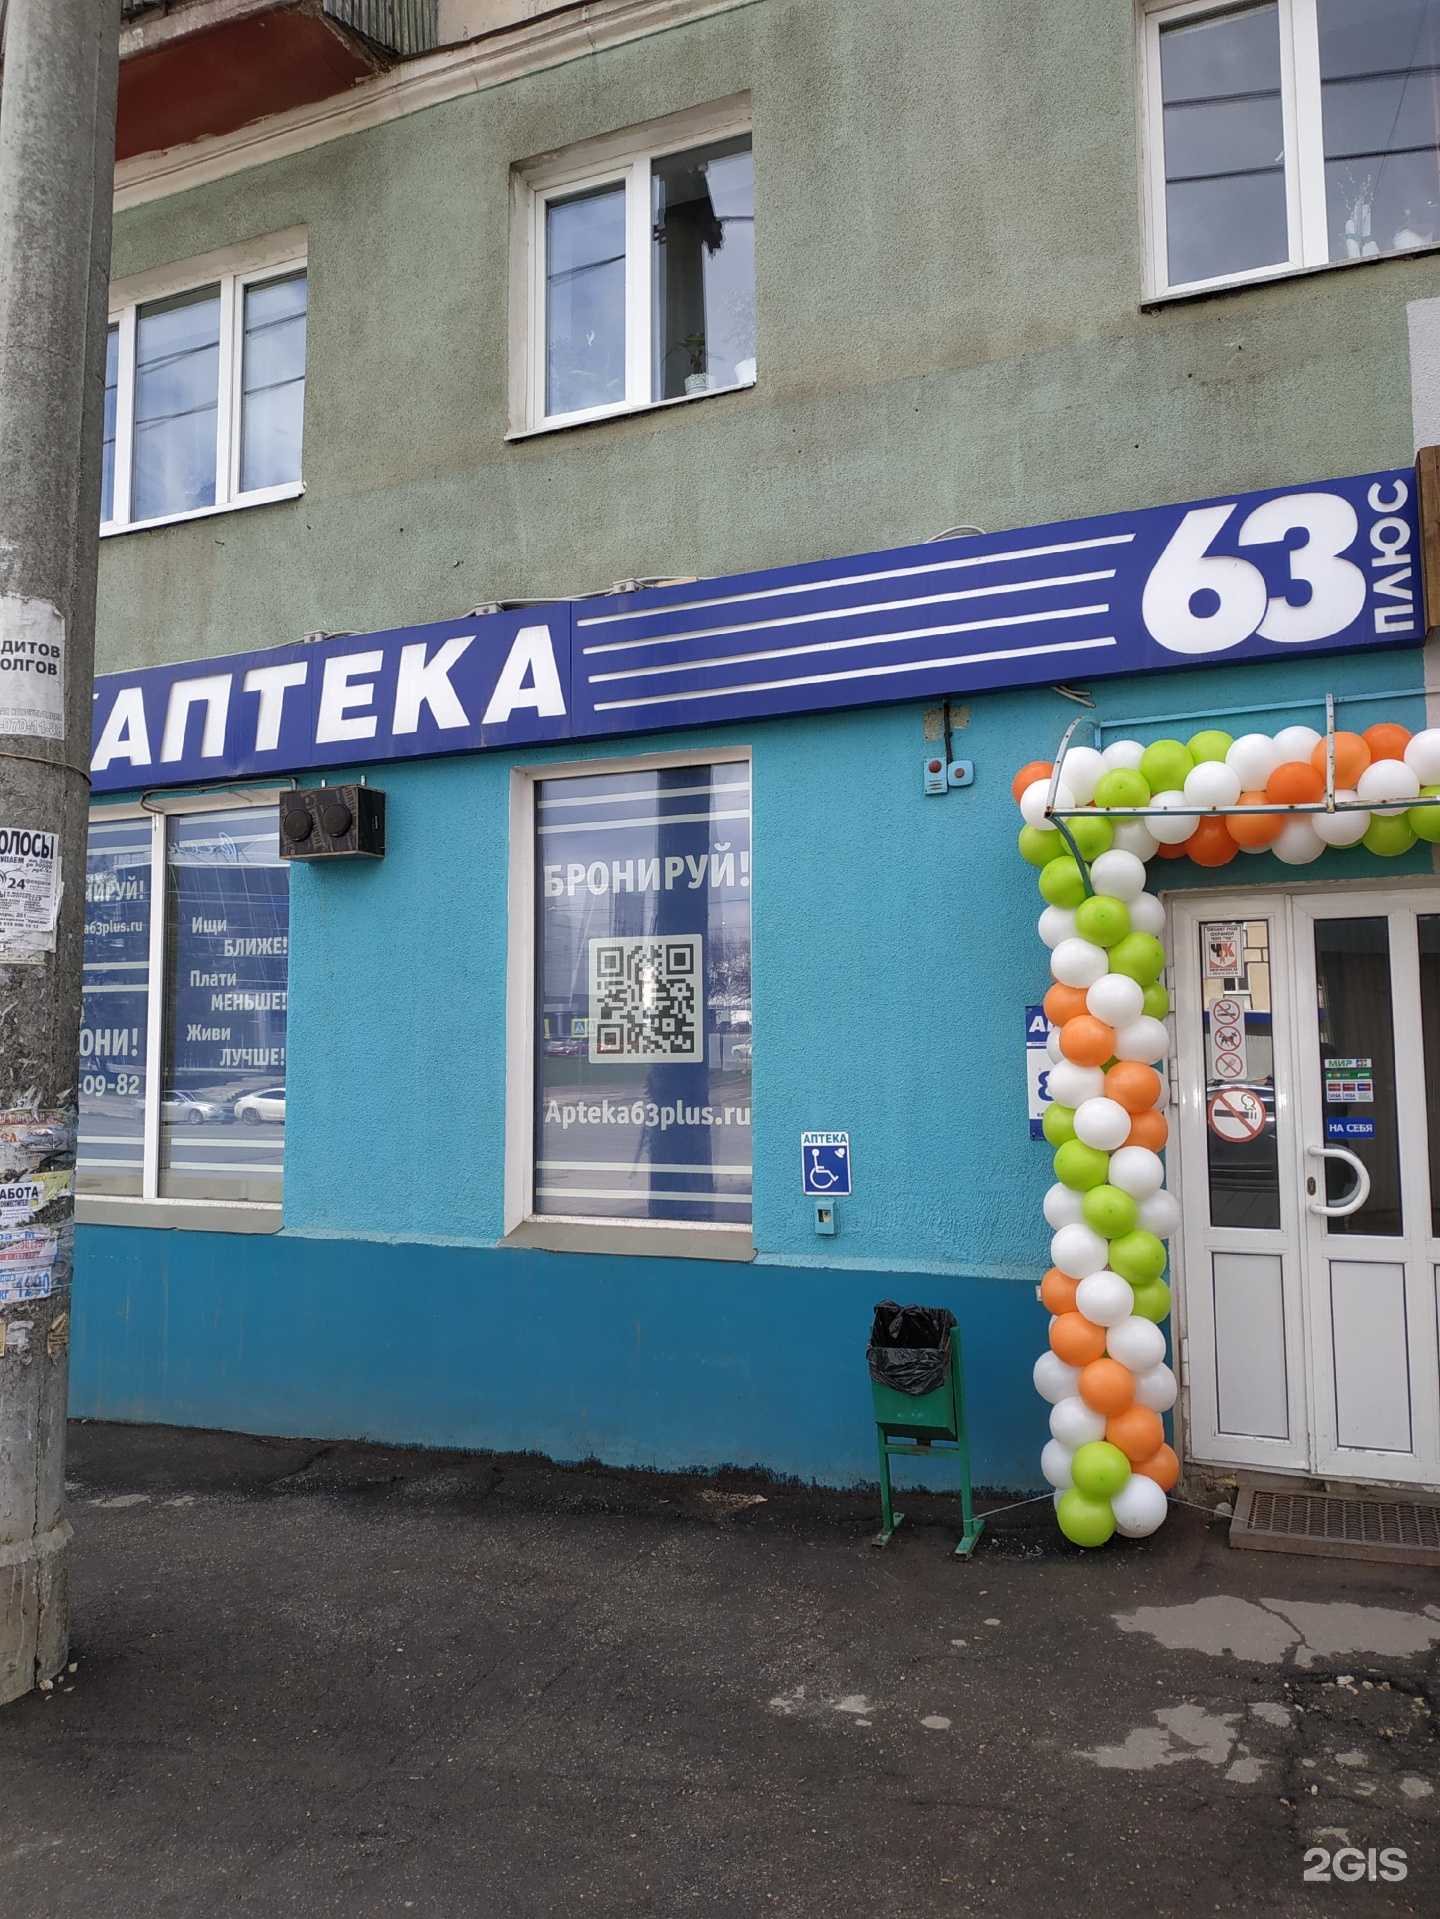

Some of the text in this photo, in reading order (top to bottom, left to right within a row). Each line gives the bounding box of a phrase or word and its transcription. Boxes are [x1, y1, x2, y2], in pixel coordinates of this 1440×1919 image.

[1368, 479, 1414, 634] ПЛЮС
[1142, 492, 1366, 654] 63
[1, 640, 60, 658] ДИТОВ
[0, 658, 57, 675] ОЛГОВ
[91, 624, 566, 771] АПТЕКА
[0, 830, 54, 859] ОЛОСЫ
[544, 842, 749, 897] БРОНИРУЙ!
[192, 917, 227, 934] Ищи
[224, 937, 288, 956] БЛИЖЕ!
[190, 970, 237, 987] Плати
[211, 993, 287, 1011] МЕНЬШЕ!
[186, 1024, 231, 1041] Живи
[219, 1048, 285, 1066] ЛУЧШЕ!
[544, 1100, 751, 1129] Apteka63plus.ru
[1329, 1124, 1373, 1132] НА СЕБЯ
[803, 1134, 848, 1144] АПТЕКА
